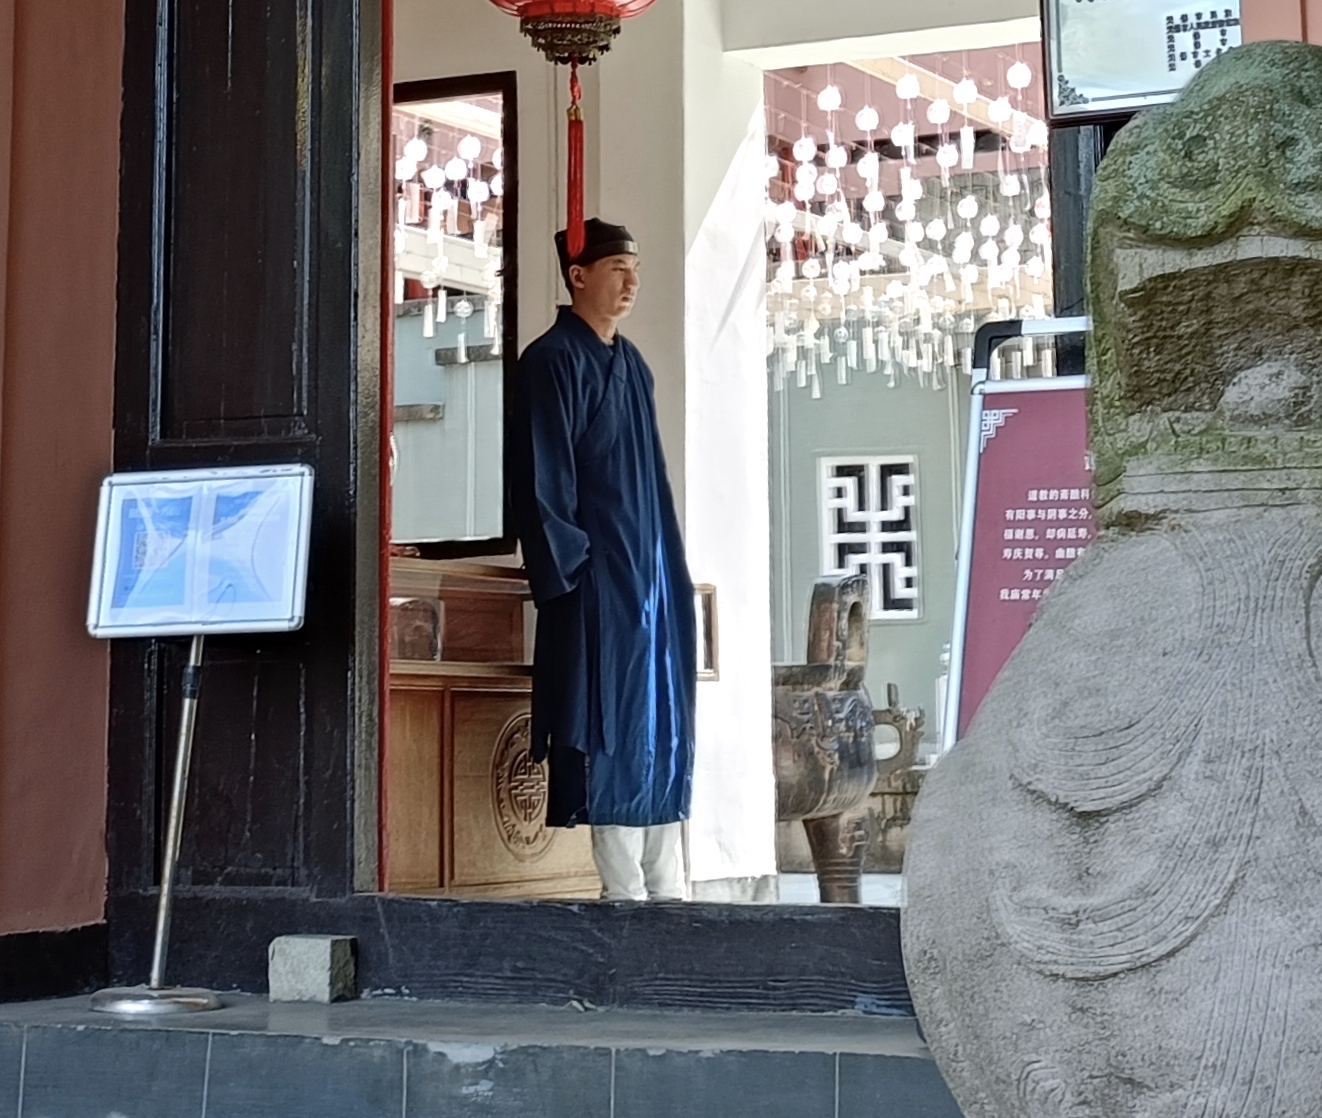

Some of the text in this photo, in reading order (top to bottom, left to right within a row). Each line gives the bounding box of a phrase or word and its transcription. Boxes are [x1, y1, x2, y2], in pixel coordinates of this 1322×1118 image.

[1027, 488, 1094, 502] 道教的斋醮科
[999, 588, 1049, 601] 我庙常年
